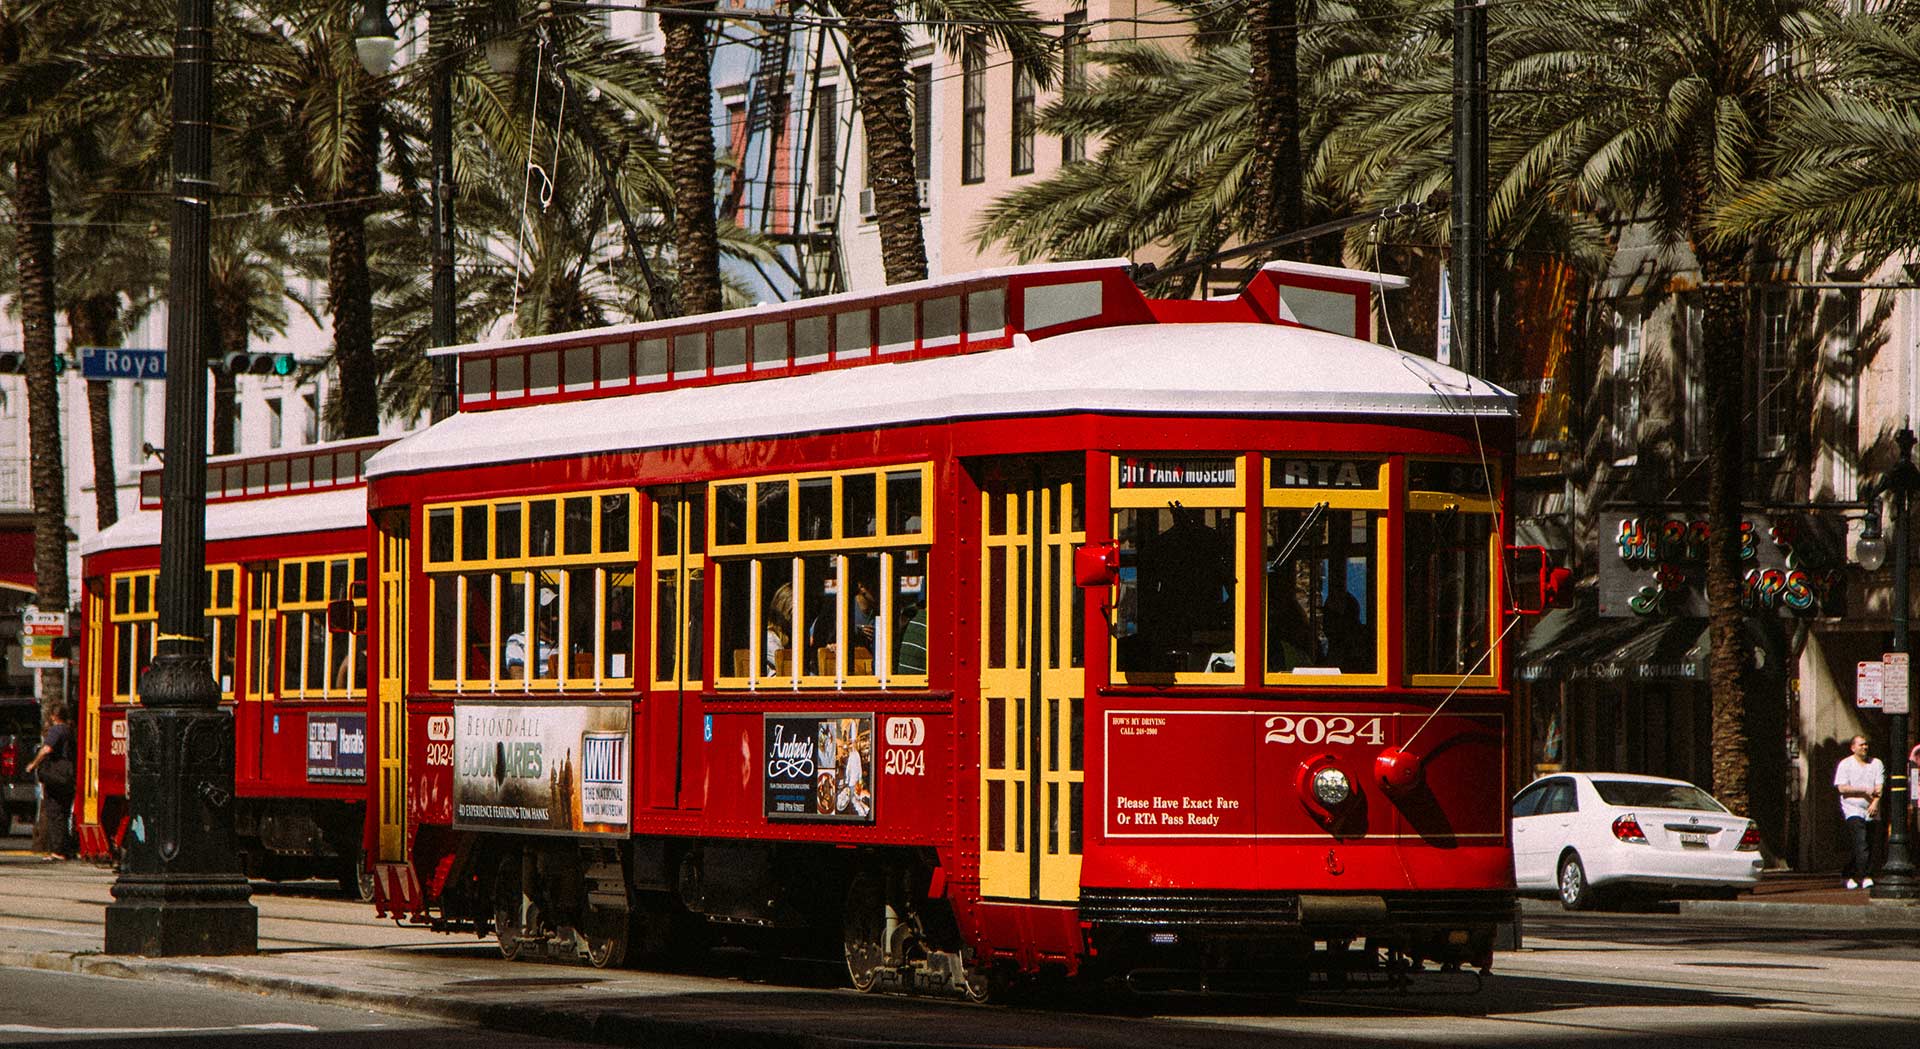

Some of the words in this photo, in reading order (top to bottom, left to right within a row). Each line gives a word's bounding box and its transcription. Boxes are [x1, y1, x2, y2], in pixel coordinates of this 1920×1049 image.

[105, 351, 167, 380] Royal
[1121, 460, 1145, 484] CITY
[1284, 460, 1362, 486] RTA
[1616, 518, 1755, 560] HIPPE
[432, 721, 443, 735] RTA
[466, 714, 513, 737] BEYOND
[519, 718, 541, 738] ALL
[893, 723, 909, 739] RTA
[1120, 727, 1135, 735] CALL
[1141, 717, 1166, 726] DRIVING
[1265, 716, 1385, 745] 2024
[769, 724, 814, 761] Andrea's
[427, 743, 455, 766] 2024
[462, 742, 543, 780] BOUNARIES
[585, 738, 623, 783] WWII
[885, 748, 926, 777] 2024
[584, 787, 596, 801] THE
[596, 787, 624, 802] NATIONAL
[1117, 796, 1150, 809] Please
[1153, 796, 1179, 809] Have
[1182, 796, 1213, 809] Exact
[1216, 796, 1240, 809] Fare
[465, 804, 492, 818] EXPERIENCE
[492, 805, 520, 819] FEATURING
[519, 806, 532, 820] TOM
[531, 808, 549, 821] HANKS
[600, 803, 624, 817] MUSEUM
[1117, 812, 1131, 825] Or
[1134, 812, 1158, 825] RTA
[1161, 812, 1184, 825] Pass
[1187, 812, 1220, 827] Ready
